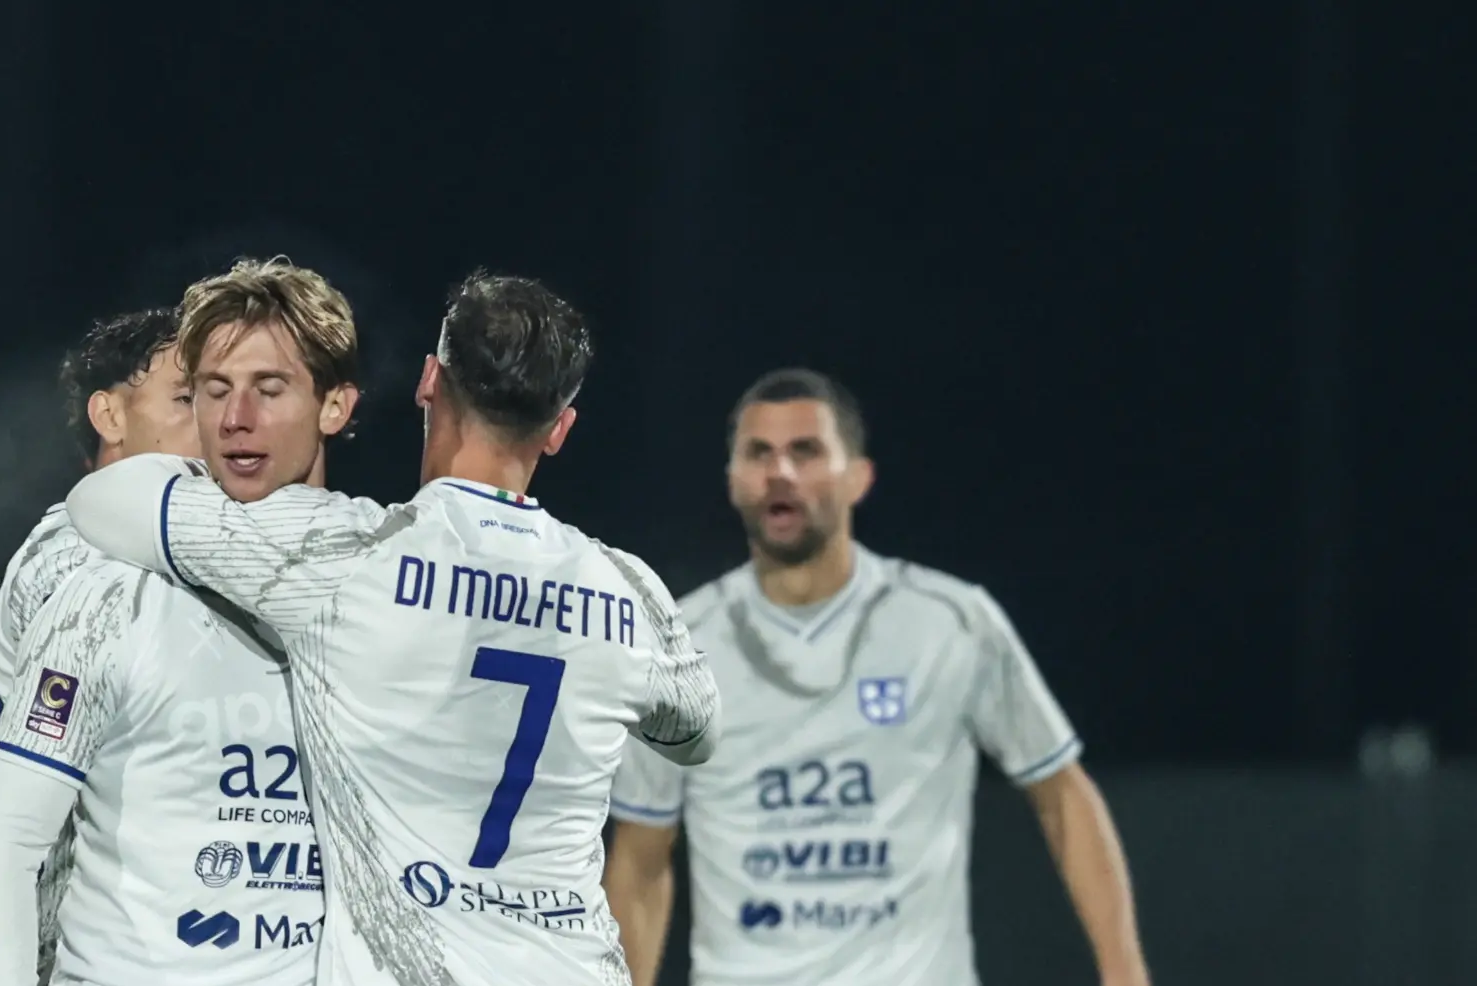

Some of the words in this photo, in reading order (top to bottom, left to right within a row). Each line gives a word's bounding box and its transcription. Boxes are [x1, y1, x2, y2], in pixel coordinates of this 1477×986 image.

[395, 555, 435, 610] DI
[448, 565, 635, 648] MOLFETTA
[470, 646, 566, 868] 7
[757, 760, 876, 811] a2a
[218, 807, 255, 822] LIFE
